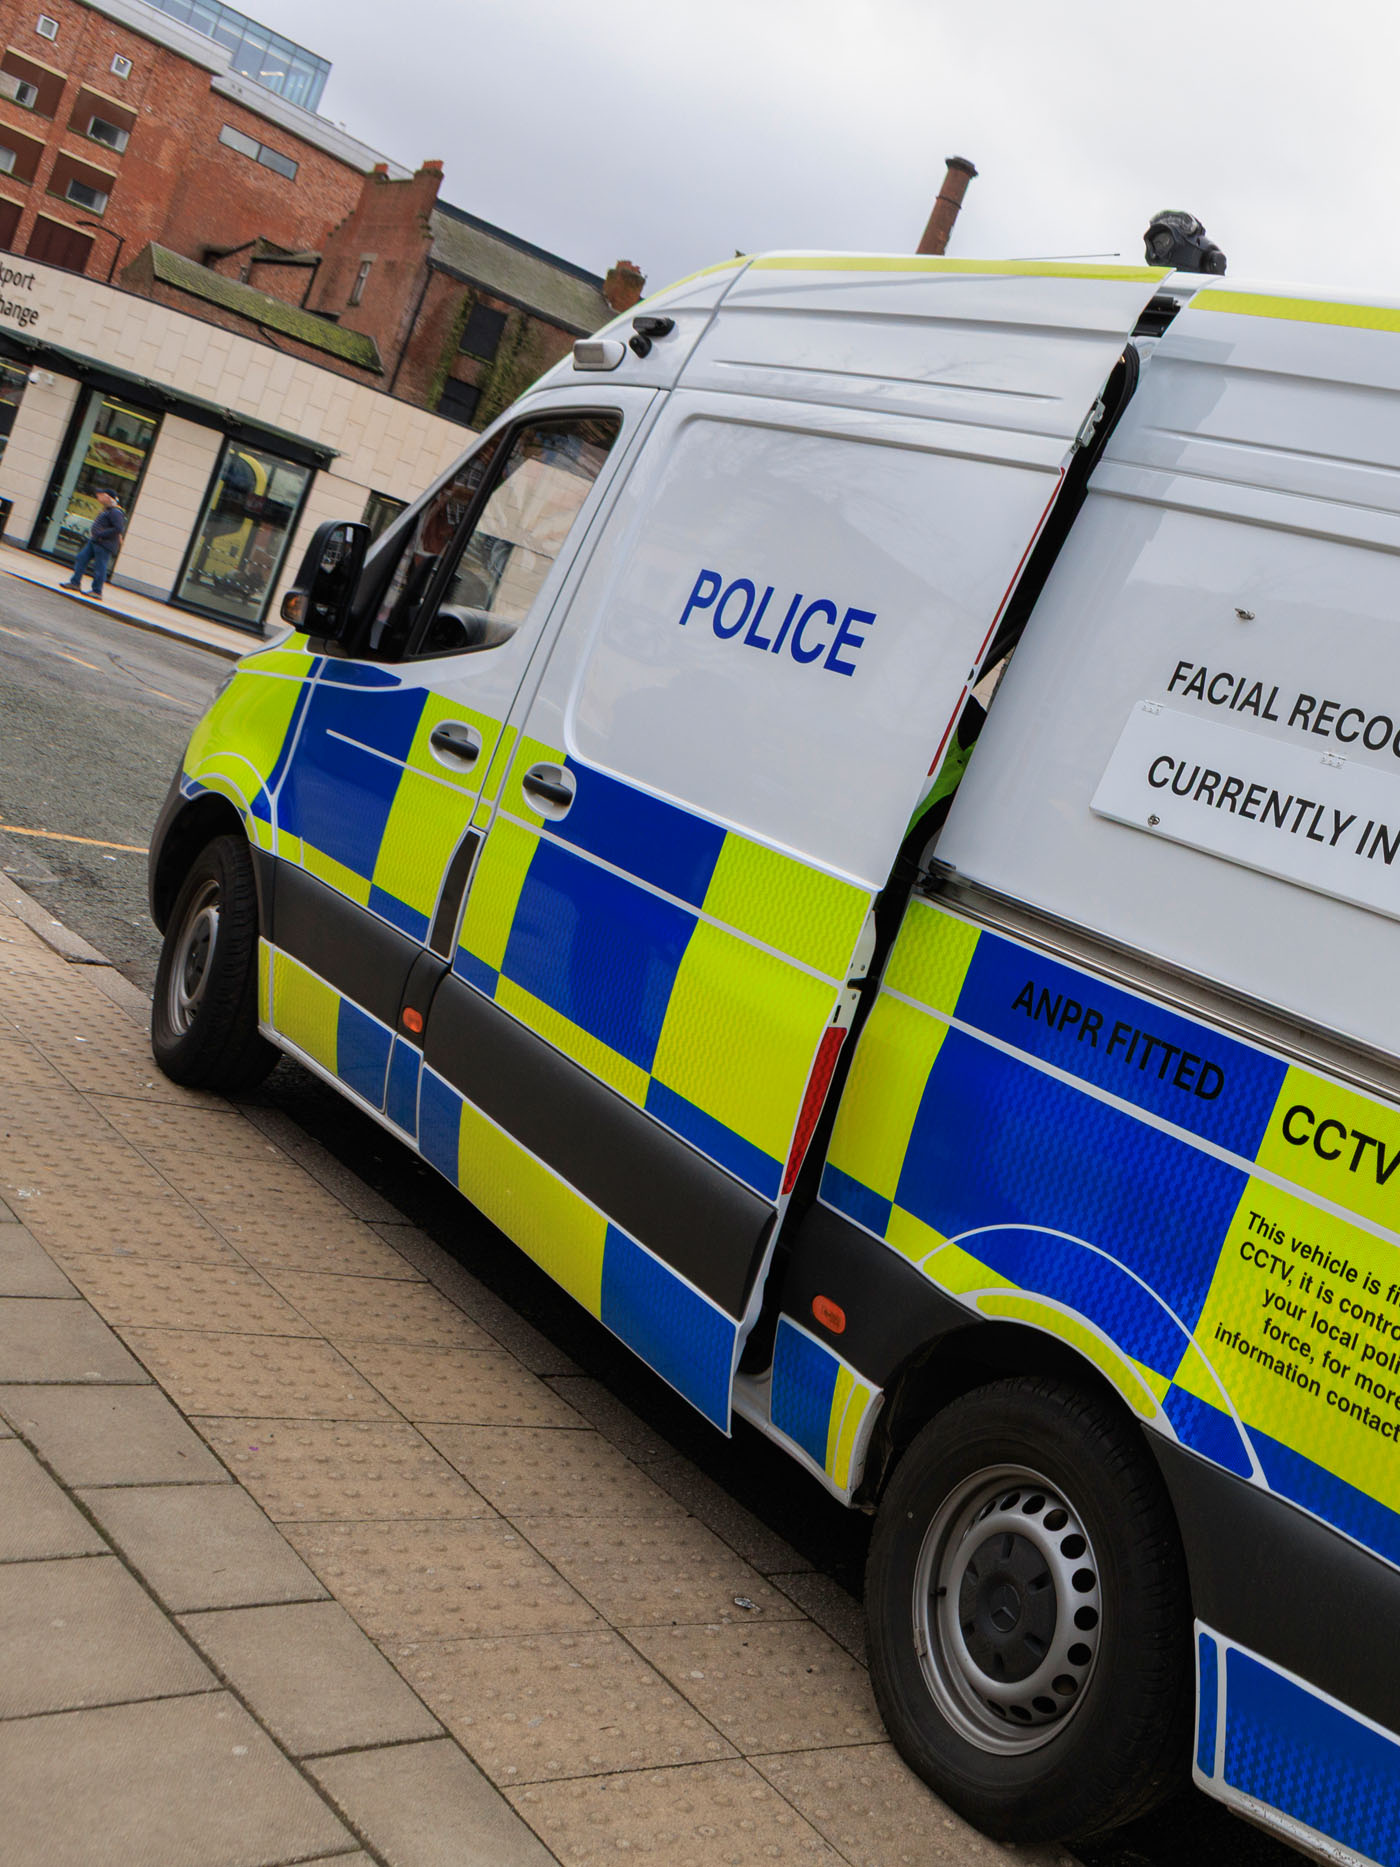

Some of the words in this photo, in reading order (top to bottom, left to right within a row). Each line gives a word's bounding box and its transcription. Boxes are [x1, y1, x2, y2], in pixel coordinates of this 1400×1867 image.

[678, 568, 878, 677] POLICE
[1166, 660, 1279, 722] FACIAL
[1147, 755, 1356, 847] CURRENTLY
[1010, 980, 1104, 1048] ANPR
[1105, 1020, 1225, 1101] FITTED
[1239, 1241, 1294, 1287] CCTV,
[1299, 1271, 1315, 1294] it
[1316, 1281, 1335, 1305] is
[1247, 1210, 1286, 1246] This
[1291, 1237, 1358, 1283] vehicle
[1362, 1271, 1382, 1295] is
[1262, 1288, 1307, 1321] your
[1310, 1311, 1360, 1350] local
[1262, 1317, 1315, 1364] force,
[1322, 1350, 1351, 1379] for
[1214, 1321, 1321, 1397] information
